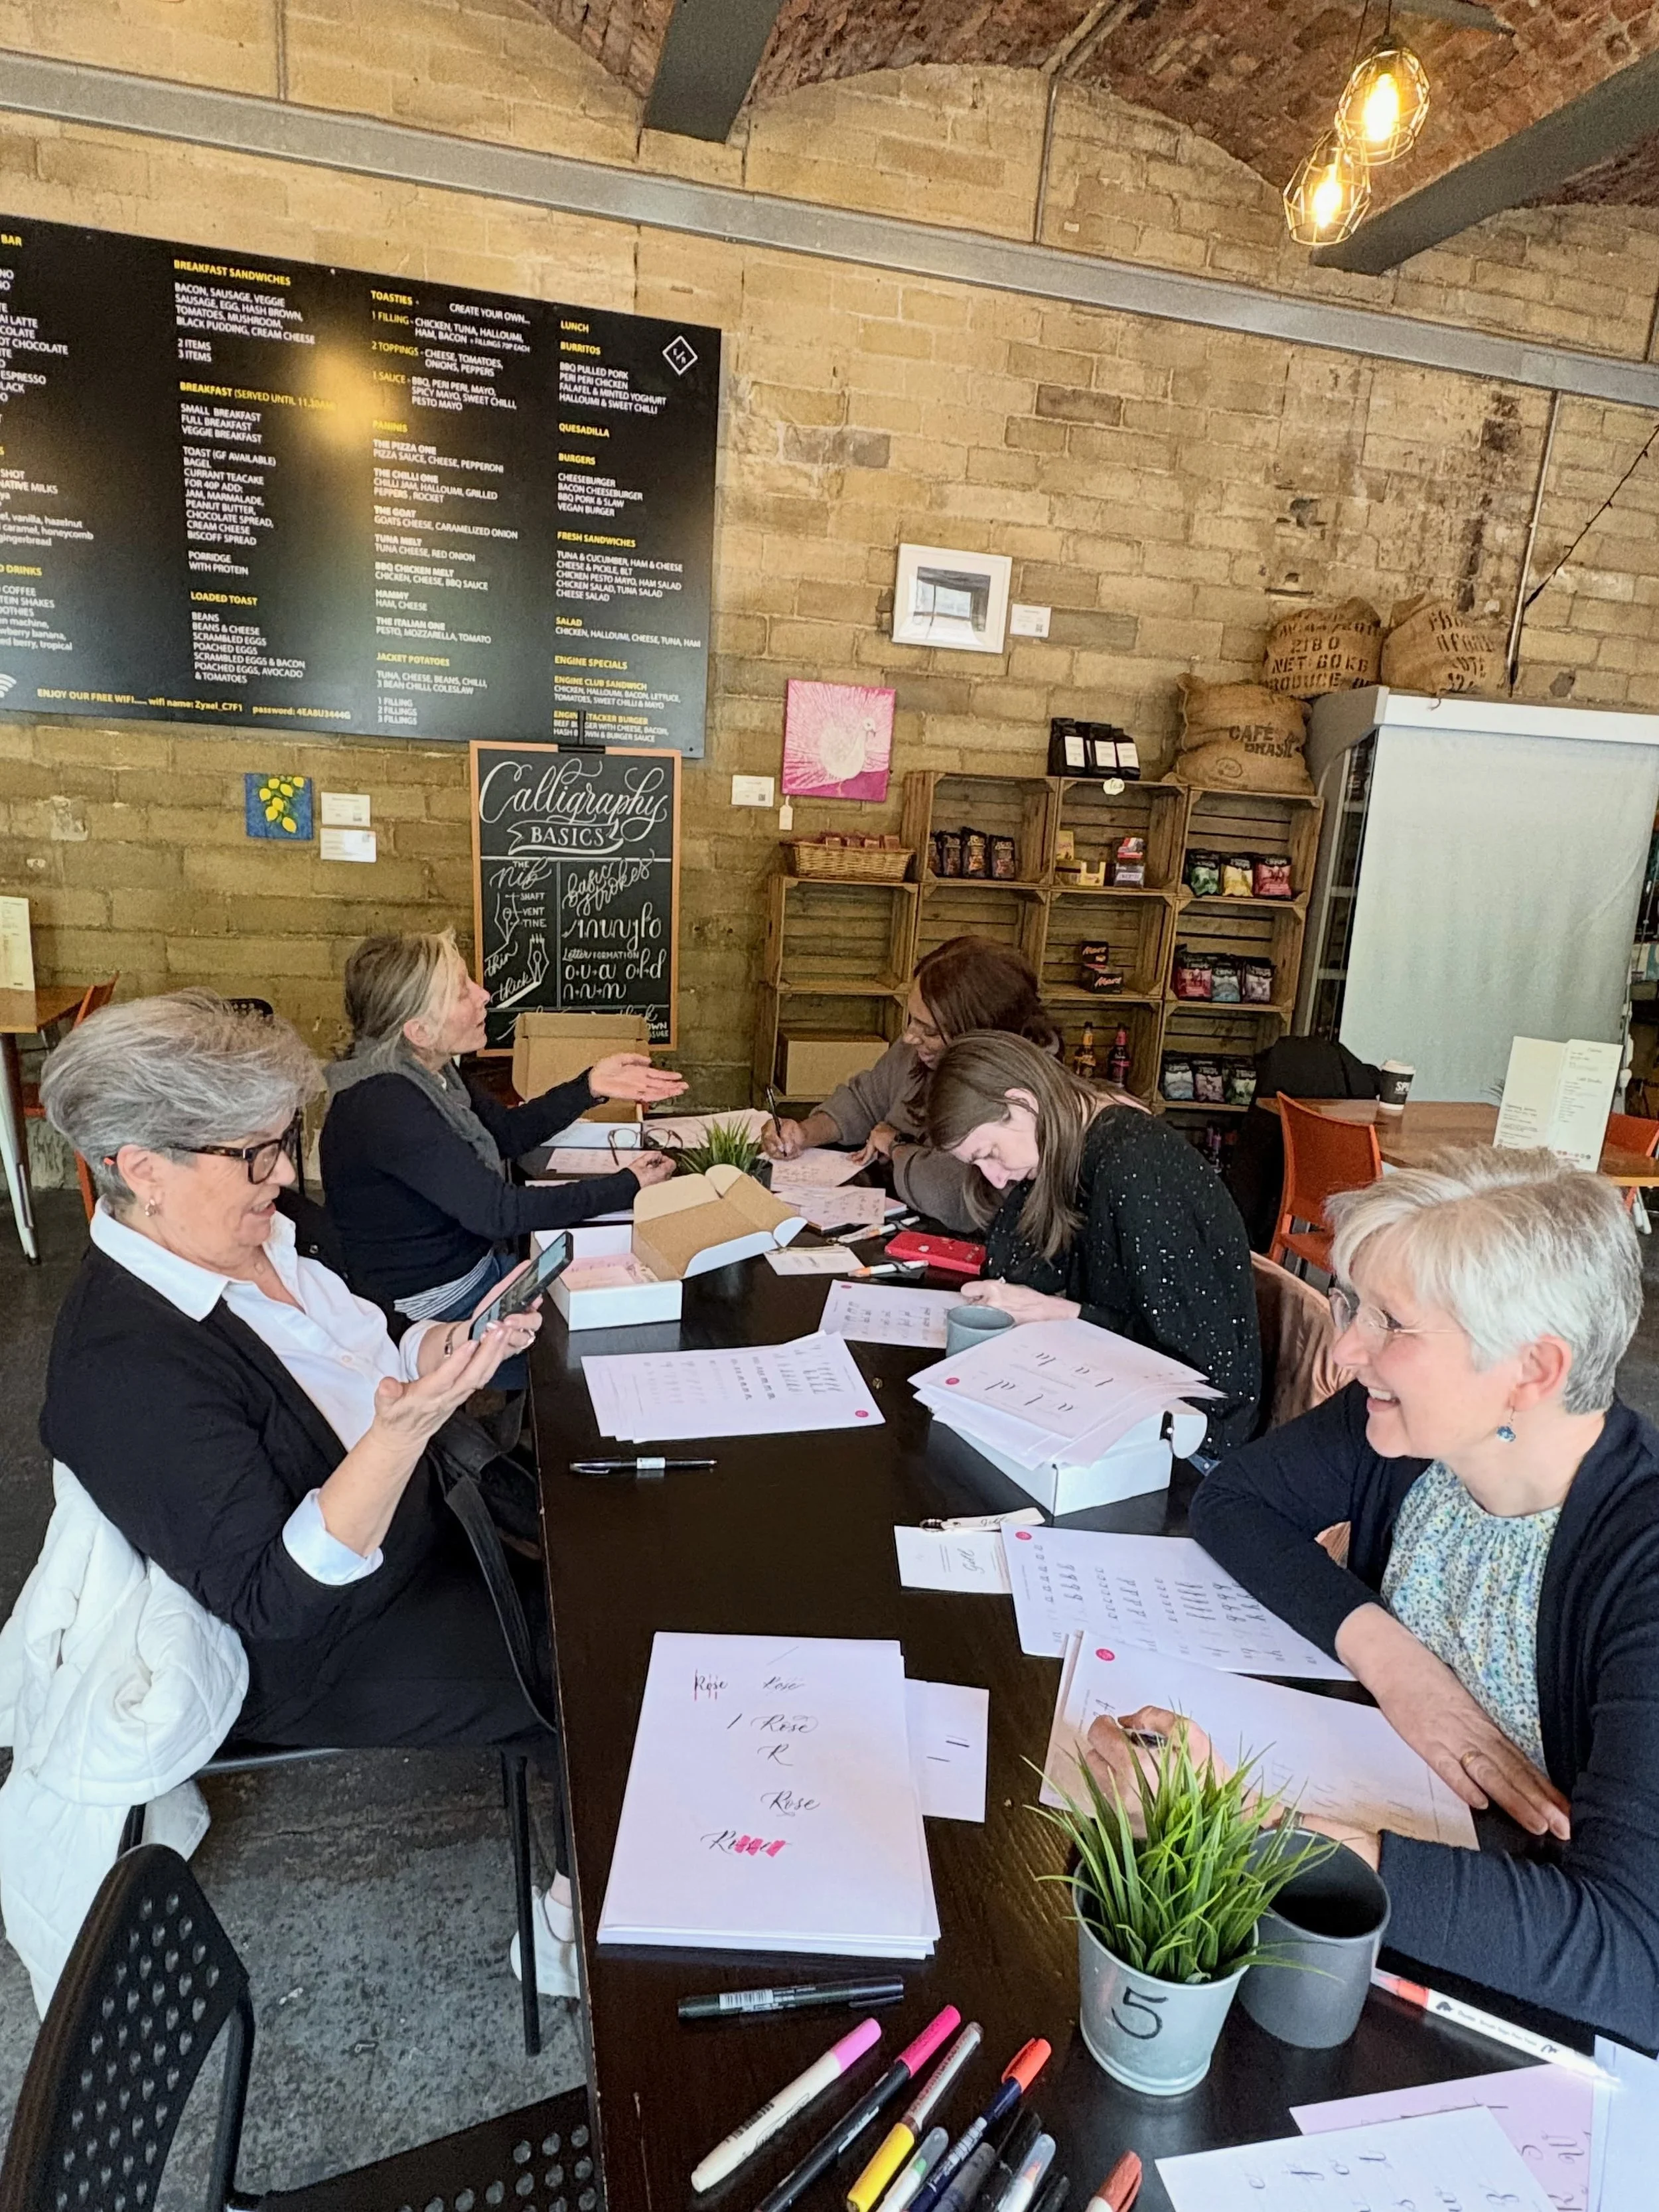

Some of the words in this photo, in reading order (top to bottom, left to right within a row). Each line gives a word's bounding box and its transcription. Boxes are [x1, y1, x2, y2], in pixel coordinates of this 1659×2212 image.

[173, 259, 227, 276] BREAKFAST
[229, 267, 291, 285] SANDWICHES
[253, 294, 285, 307] VEGGIE
[370, 290, 412, 305] TOASTIES
[242, 303, 267, 315] HASH
[9, 315, 37, 327] LATTE
[560, 320, 589, 332] LUNCH
[176, 316, 204, 329] BLACK
[251, 327, 281, 339] CREAM
[283, 331, 316, 344] CHEESE
[11, 338, 68, 354] CHOCOLATE
[184, 338, 211, 350] ITEMS
[560, 340, 601, 355] BURRITOS
[184, 350, 211, 362] ITEMS
[0, 370, 46, 384] ESPRESSO
[461, 364, 494, 377] PEPPERS
[559, 361, 576, 373] BBQ
[577, 364, 607, 377] PULLED
[608, 368, 628, 380] PORK
[559, 372, 575, 382] PERI
[577, 374, 593, 385] PERI
[595, 376, 628, 390] CHICKEN
[411, 386, 434, 397] SPICY
[463, 393, 488, 405] SWEET
[559, 382, 591, 395] FALAFEL
[599, 388, 629, 400] MINTED
[630, 392, 666, 406] YOGHURT
[411, 395, 437, 407] PESTO
[438, 399, 463, 411] MAYO
[559, 392, 599, 406] HALLOUMI
[608, 399, 632, 411] SWEET
[634, 403, 657, 414] CHILLI
[180, 403, 210, 415] SMALL
[213, 407, 261, 421] BREAKFAST
[181, 414, 202, 425] FULL
[204, 417, 252, 431] BREAKFAST
[559, 422, 609, 438] QUESADILLA
[181, 425, 213, 437] VEGGIE
[214, 429, 261, 443] BREAKFAST
[183, 456, 211, 469] BAGEL
[558, 452, 595, 465] BURGERS
[183, 467, 224, 480] CURRANT
[226, 472, 263, 484] TEACAKE
[557, 472, 615, 488] CHEESEBURGER
[31, 482, 58, 494] MILKS
[557, 482, 585, 494] BACON
[585, 485, 642, 500] CHEESEBURGER
[185, 498, 220, 511] PEANUT
[557, 502, 583, 513] VEGAN
[585, 505, 614, 516] BURGER
[186, 509, 237, 523] CHOCOLATE
[373, 514, 401, 526] GOATS
[435, 522, 490, 536] CARAMELIZED
[491, 528, 518, 539] ONION
[557, 530, 582, 542] FRESH
[583, 534, 635, 548] SANDWICHES
[188, 550, 231, 563] PORRIDGE
[5, 564, 42, 576] DRINKS
[188, 561, 211, 571] WITH
[212, 563, 248, 575] PROTEIN
[1, 585, 36, 596] COFFEE
[555, 588, 583, 599] CHEESE
[585, 591, 609, 602] SALAD
[20, 597, 54, 609] SHAKES
[190, 591, 228, 603] LOADED
[228, 595, 257, 606] TOAST
[191, 611, 219, 622] BEANS
[555, 616, 582, 627] SALAD
[192, 631, 243, 644] SCRAMBLED
[244, 636, 267, 646] EGGS
[193, 641, 234, 653] POACHED
[235, 644, 257, 655] EGGS
[376, 652, 407, 663] JACKET
[408, 654, 449, 666] POTATOES
[554, 654, 587, 666] ENGINE
[588, 658, 627, 670] SPECIALS
[554, 674, 583, 686] ENGINE
[584, 677, 604, 687] CLUB
[605, 678, 647, 691] SANDWICH
[1245, 743, 1292, 758] BRASIL
[479, 758, 668, 842] Calligraphy
[531, 826, 604, 846] BASICS
[520, 892, 545, 901] SHAFT
[522, 907, 545, 916] VENT
[522, 919, 547, 928] TINE
[490, 972, 532, 1003] thick
[758, 1744, 794, 1766] R
[760, 1791, 820, 1817] Rose
[1111, 1988, 1168, 2039] 5
